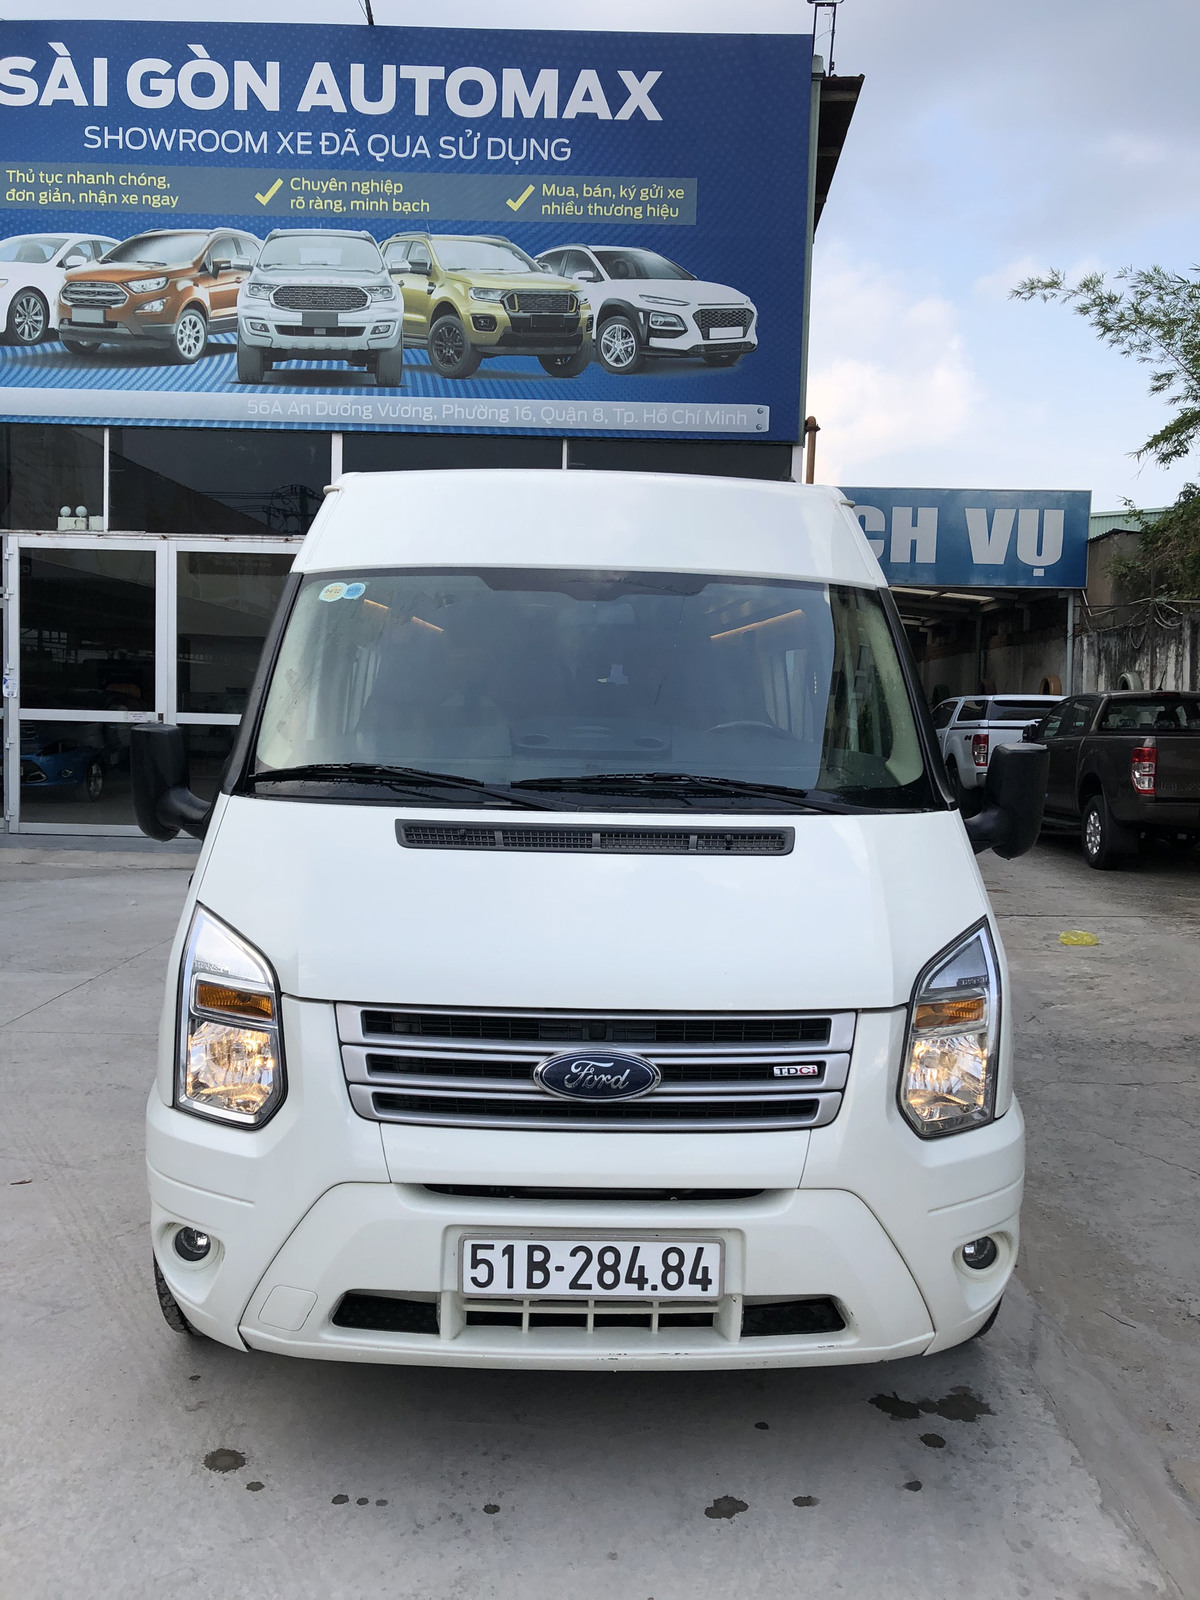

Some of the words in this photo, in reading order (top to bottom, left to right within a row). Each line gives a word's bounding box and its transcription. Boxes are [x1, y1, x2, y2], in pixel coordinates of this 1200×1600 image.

[0, 42, 108, 107] SÀI
[126, 43, 280, 112] GÒN
[296, 61, 664, 121] AUTOMAX
[83, 125, 268, 154] SHOWROOM
[276, 131, 312, 155] XE
[319, 128, 361, 156] ĐÃ
[367, 134, 431, 162] QUA
[438, 129, 481, 160] SỬ
[487, 137, 572, 165] DỤNG
[6, 168, 34, 183] Thủ
[39, 170, 63, 186] tục
[66, 171, 115, 185] nhanh
[118, 172, 171, 189] chóng,
[290, 177, 348, 194] Chuyên
[351, 179, 403, 195] nghiệp
[6, 188, 35, 201] đơn
[39, 188, 75, 204] giản,
[79, 190, 117, 206] nhận
[121, 194, 138, 204] xe
[142, 194, 179, 208] ngay
[542, 183, 579, 198] Mua,
[582, 184, 615, 199] bán,
[619, 184, 636, 200] ký
[640, 184, 663, 201] gửi
[667, 188, 685, 199] xe
[290, 196, 305, 209] rõ
[309, 196, 346, 212] ràng,
[350, 198, 388, 211] minh
[392, 198, 430, 214] bạch
[541, 201, 583, 216] nhiều
[587, 203, 643, 219] thương
[646, 204, 679, 220] hiệu
[248, 400, 283, 415] 56A
[288, 401, 311, 415] An
[315, 402, 373, 420] Dương
[377, 403, 437, 421] Vương,
[442, 404, 509, 423] Phường
[514, 405, 536, 422] 16,
[541, 406, 587, 425] Quận
[593, 407, 608, 424] 8,
[613, 408, 638, 426] Tp.
[643, 407, 668, 425] Hồ
[672, 409, 701, 425] Chí
[704, 410, 747, 426] Minh
[965, 508, 1065, 577] VỤ
[564, 1060, 630, 1090] Ford
[775, 1066, 817, 1076] TDCi
[470, 1243, 713, 1292] 51B-284.84
